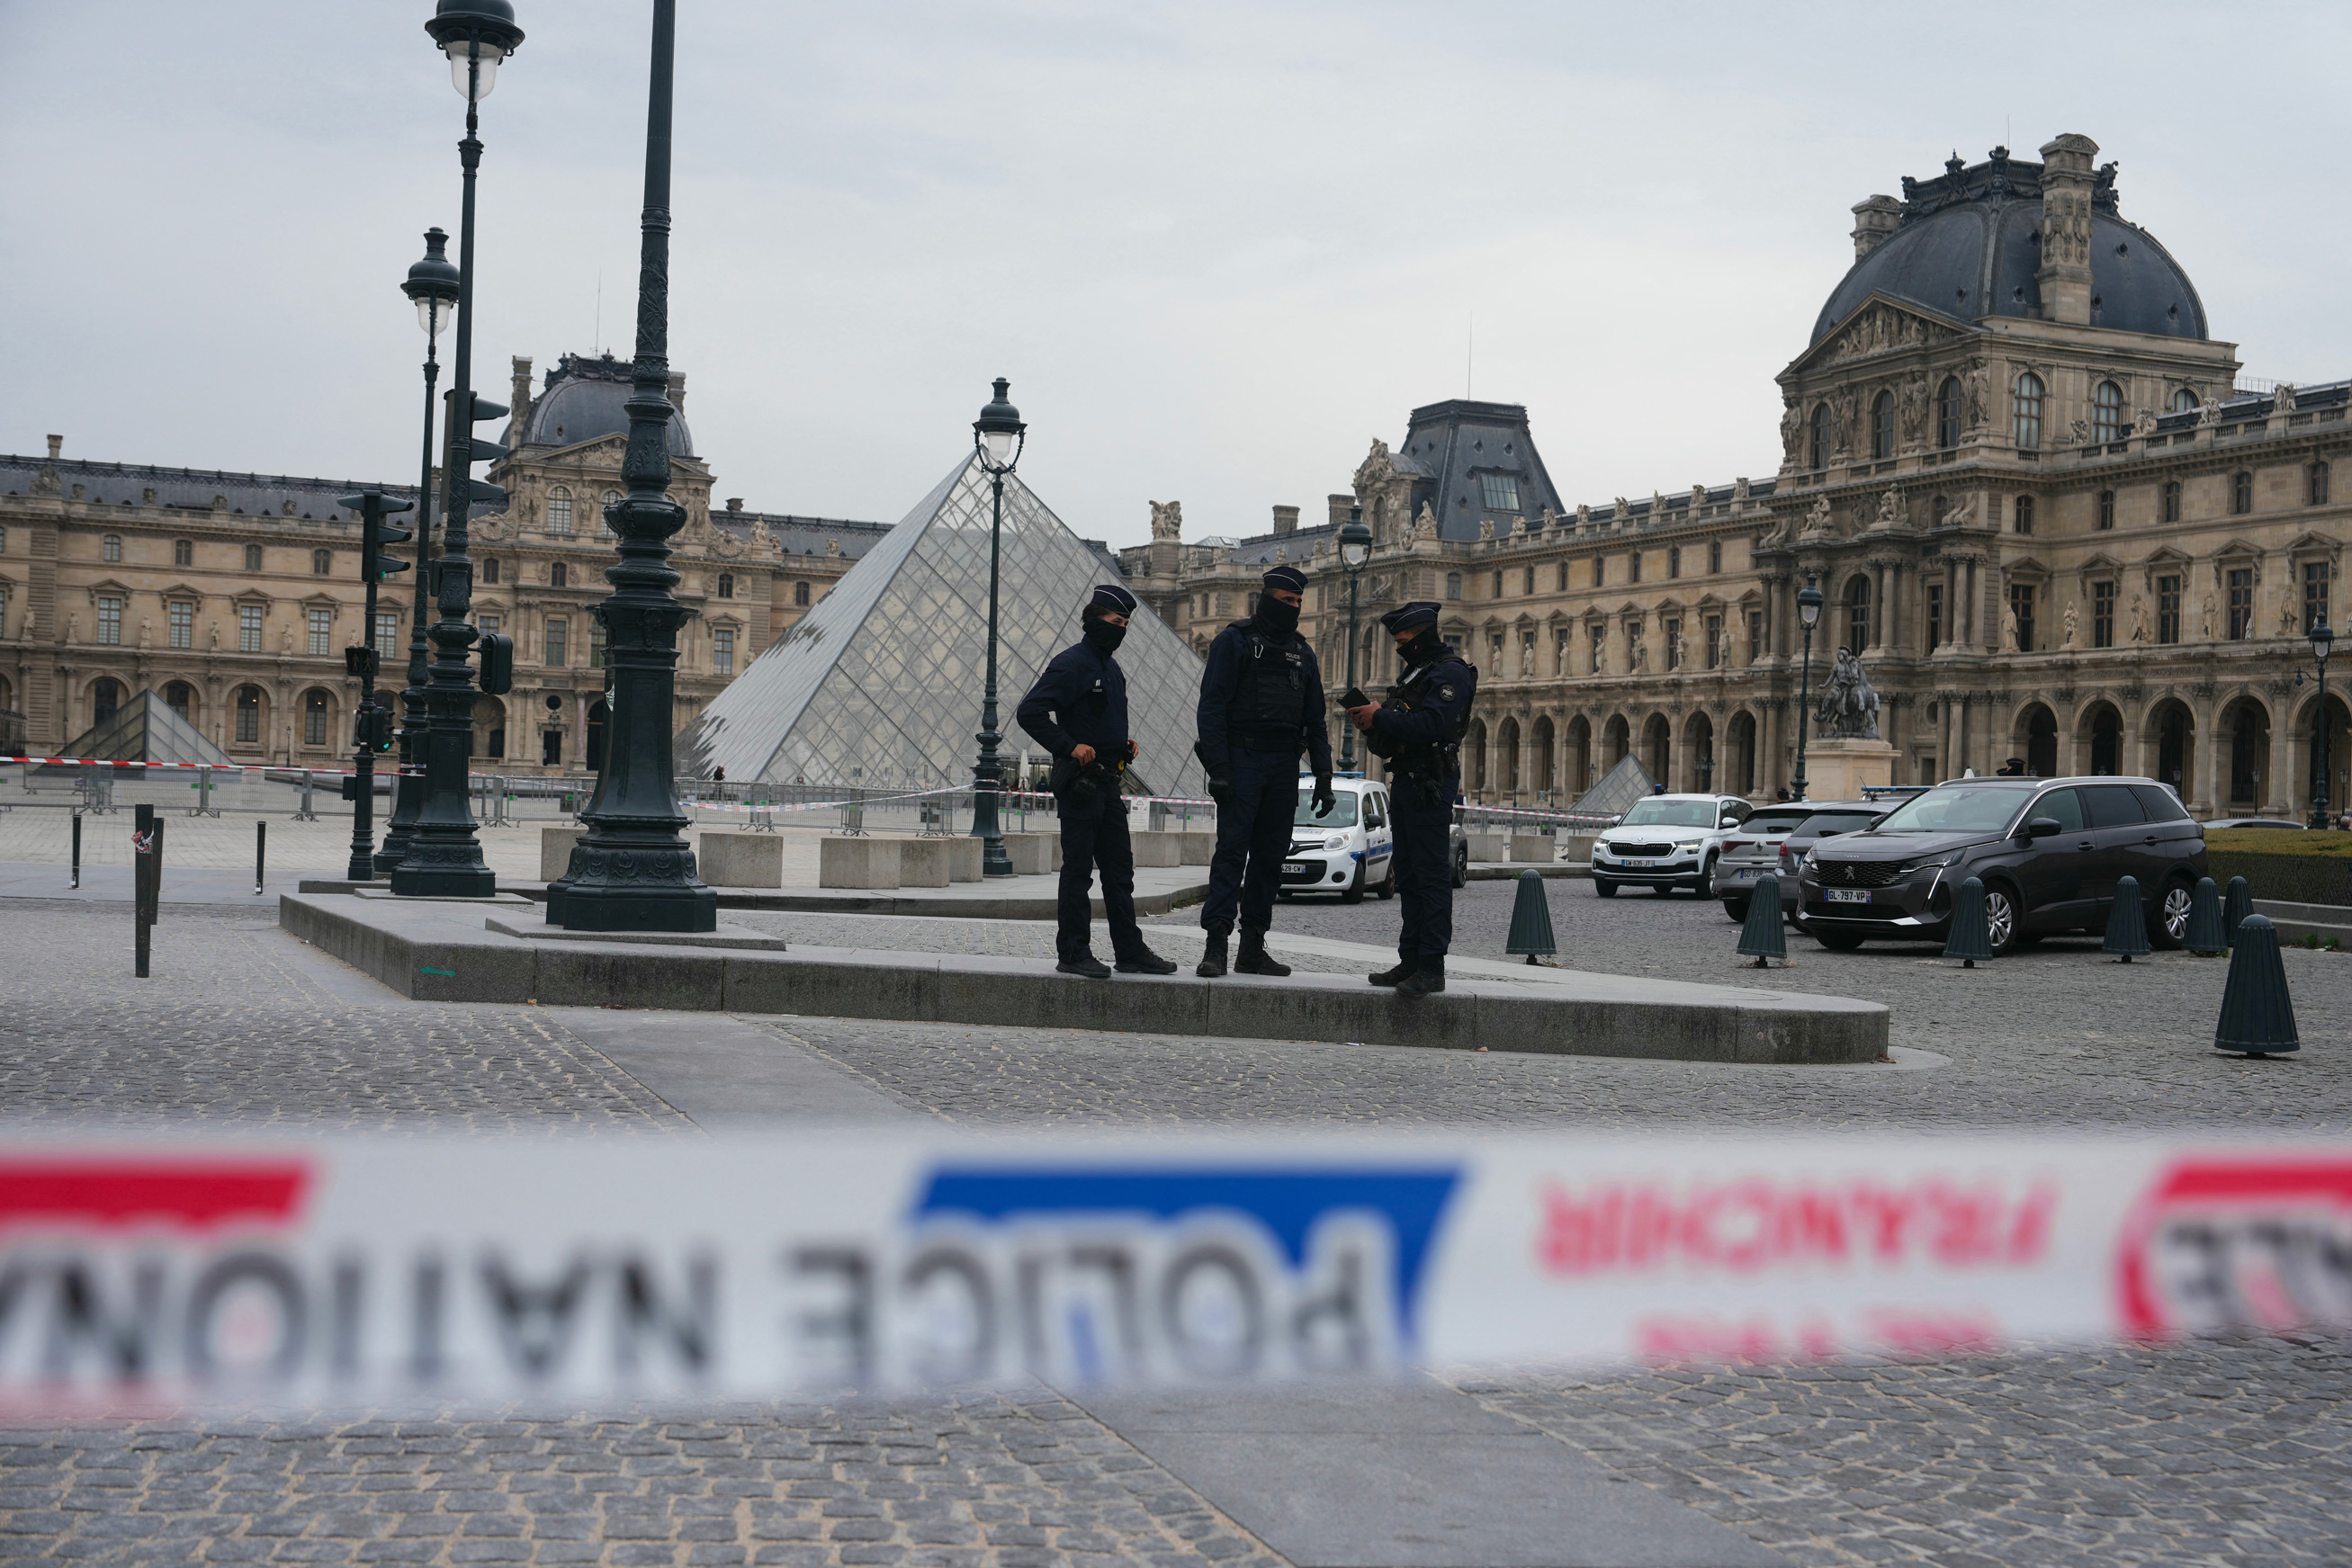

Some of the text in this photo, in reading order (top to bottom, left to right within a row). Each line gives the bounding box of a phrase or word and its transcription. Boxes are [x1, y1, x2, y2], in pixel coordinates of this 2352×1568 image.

[1828, 891, 1865, 901] GL-797-VP
[0, 1238, 1371, 1382] POLICE NATION
